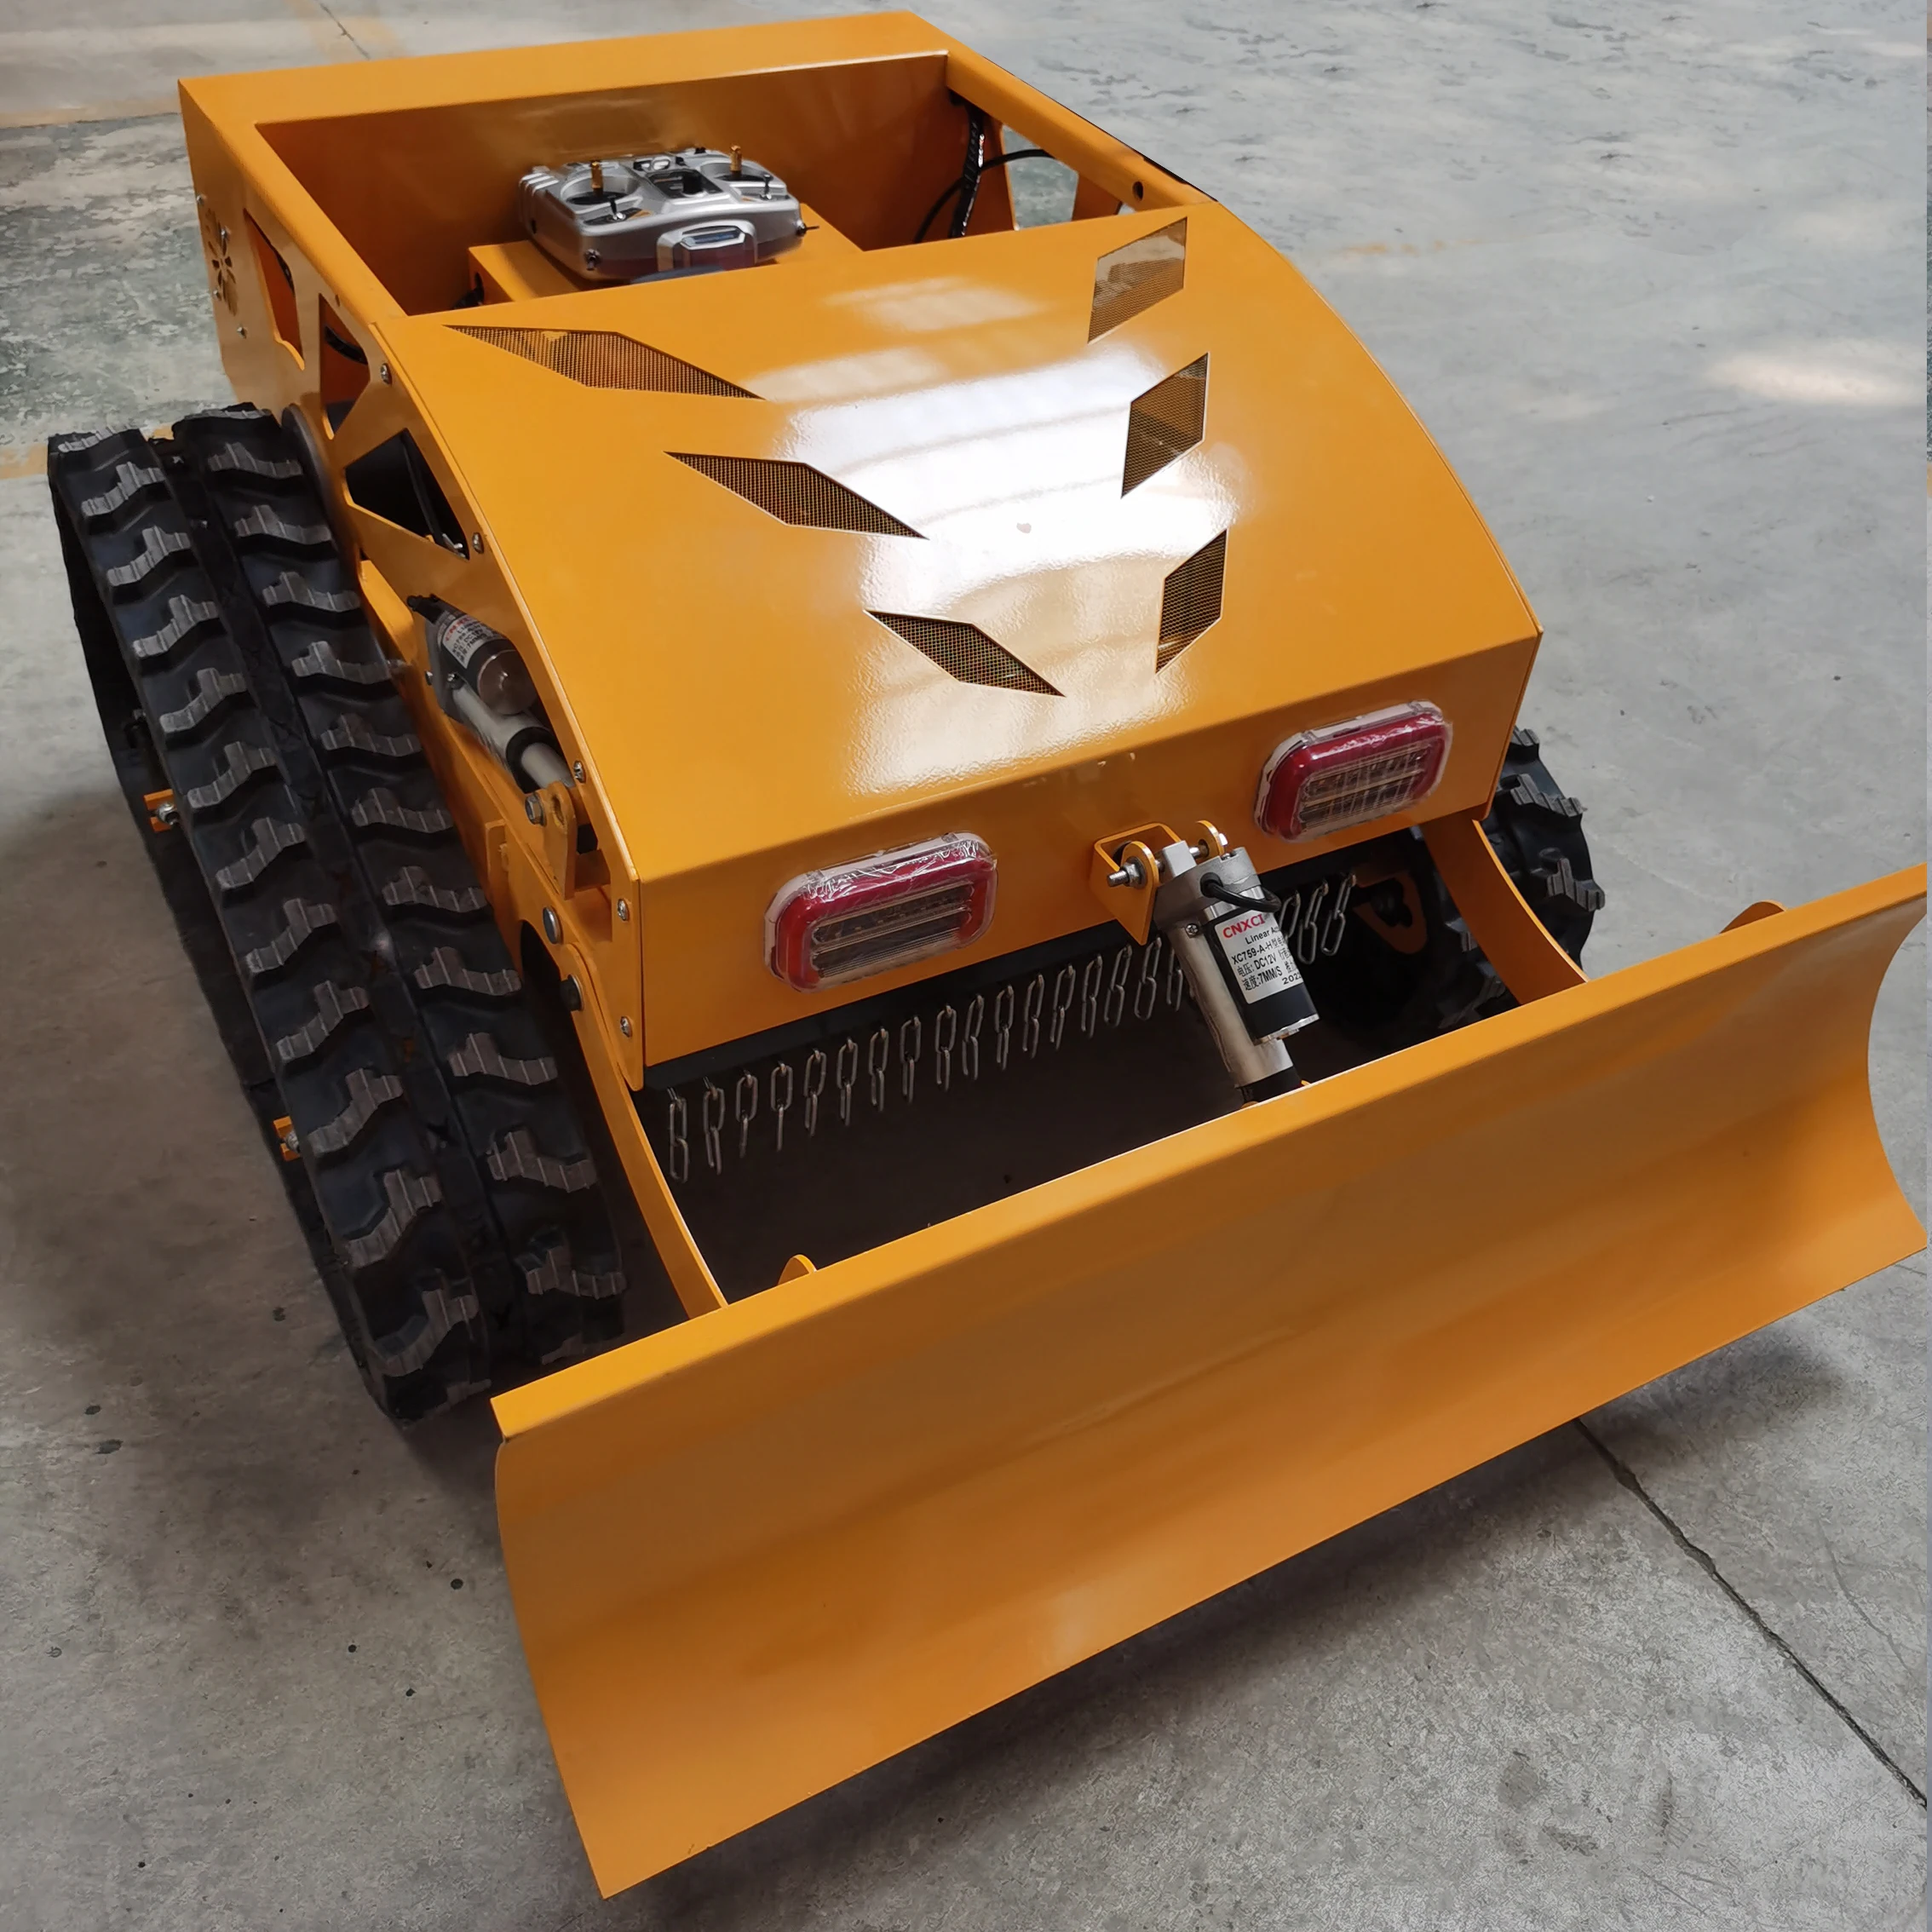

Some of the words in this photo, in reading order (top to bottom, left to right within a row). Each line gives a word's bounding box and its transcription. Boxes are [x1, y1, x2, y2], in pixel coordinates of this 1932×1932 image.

[1222, 913, 1265, 939] CNXCI
[1245, 929, 1270, 945] Linear
[1253, 953, 1277, 970] DC12V
